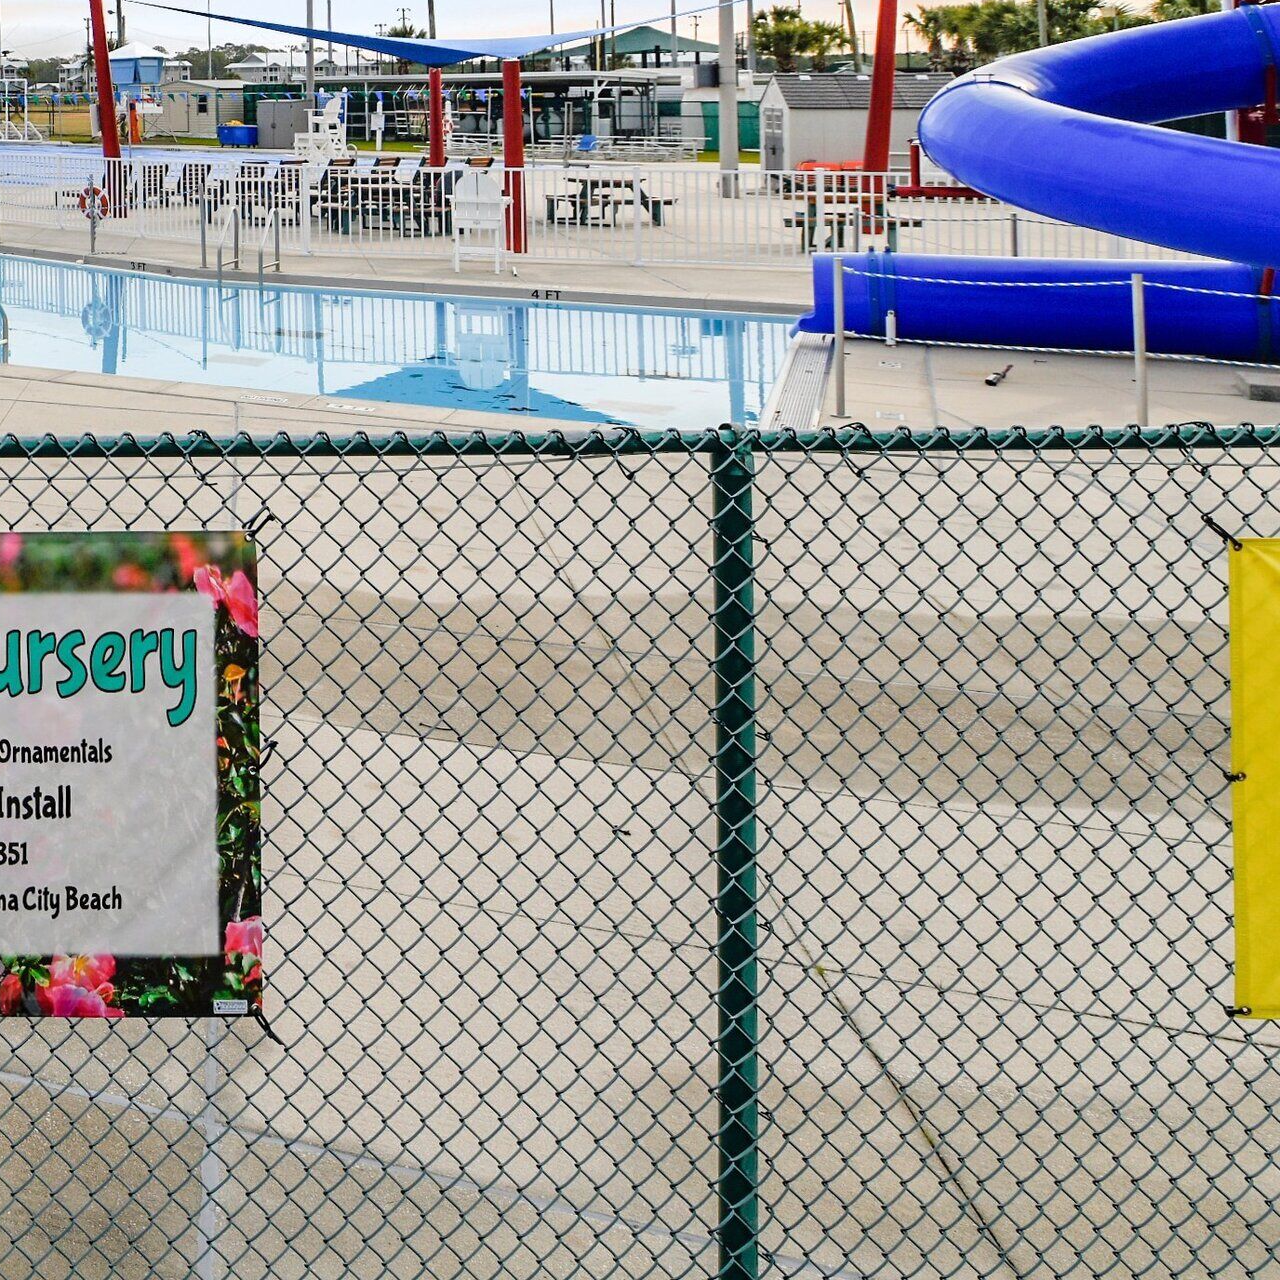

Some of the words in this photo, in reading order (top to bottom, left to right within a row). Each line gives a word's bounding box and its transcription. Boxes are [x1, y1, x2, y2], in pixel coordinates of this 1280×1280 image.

[130, 261, 136, 270] 3
[137, 262, 146, 271] FT
[531, 289, 540, 299] 4
[545, 290, 562, 300] FT
[22, 885, 61, 920] City
[65, 885, 123, 912] Beach
